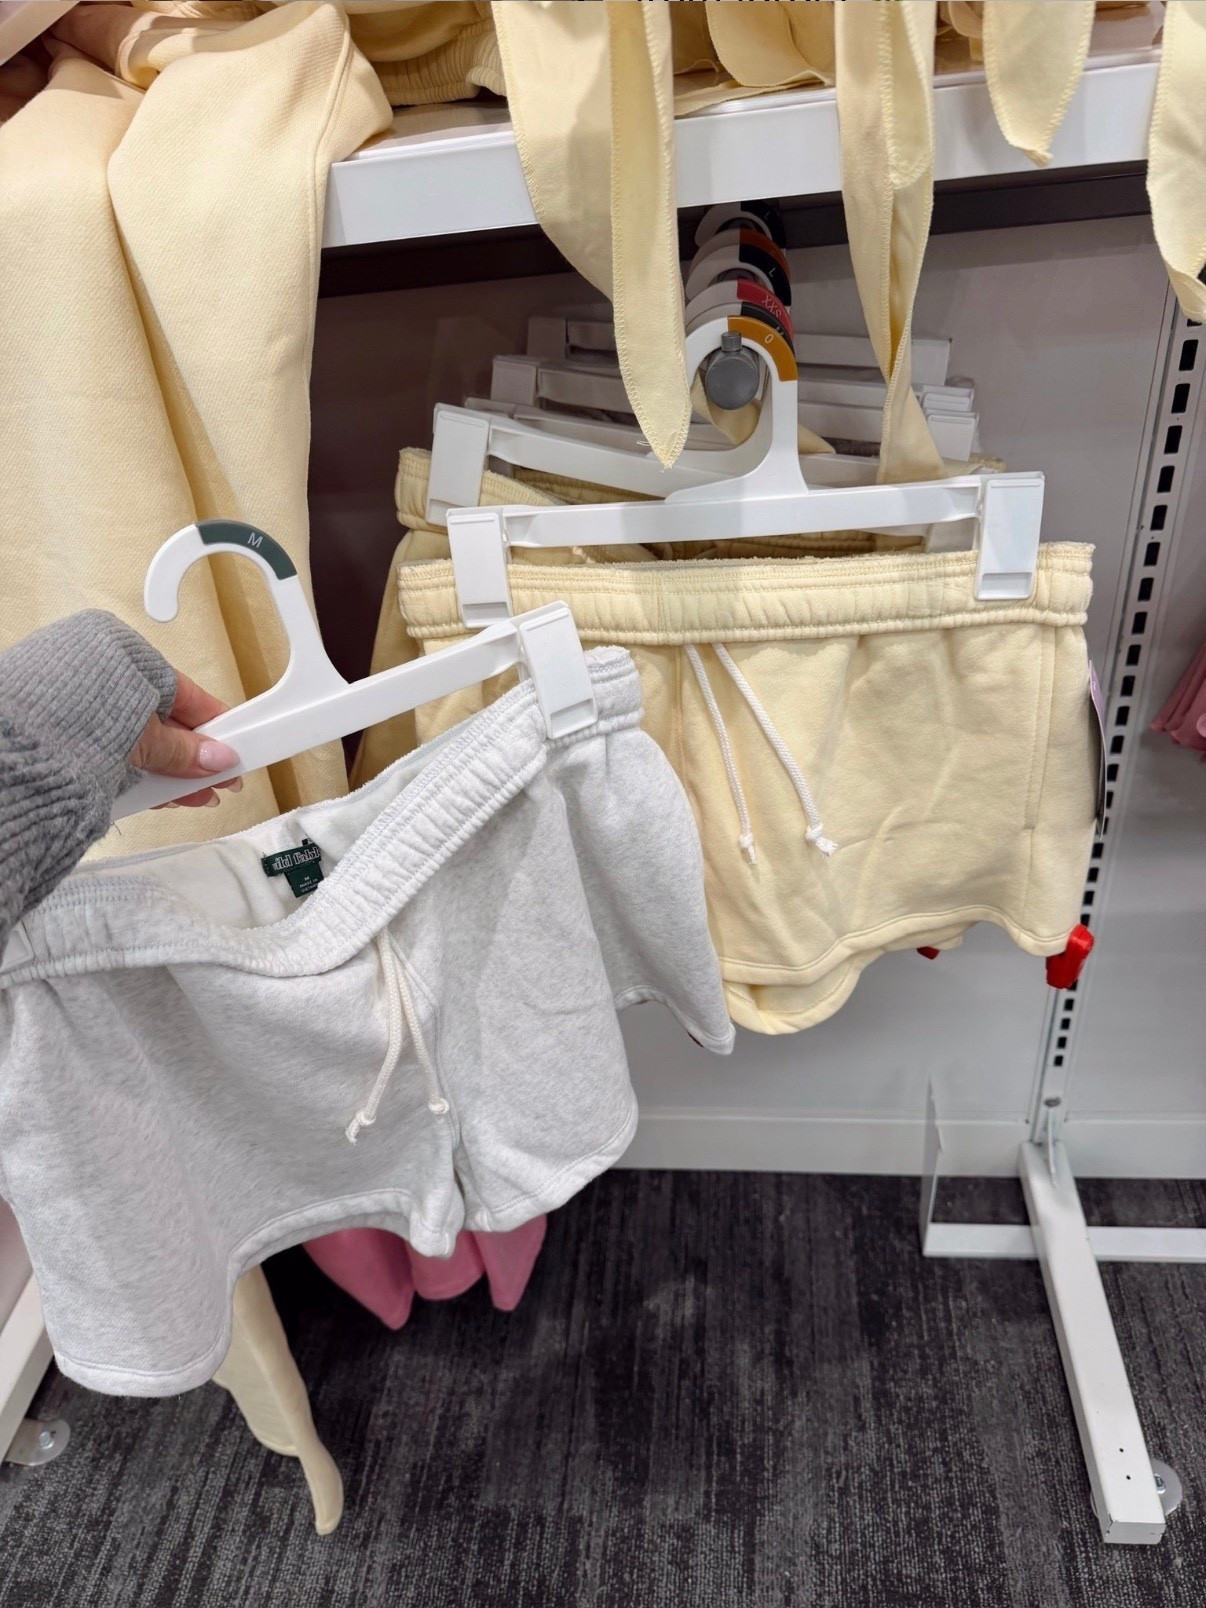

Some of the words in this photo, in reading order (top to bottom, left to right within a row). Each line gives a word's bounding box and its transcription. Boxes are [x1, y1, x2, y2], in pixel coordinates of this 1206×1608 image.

[768, 267, 776, 277] L
[761, 295, 782, 318] XXS
[247, 532, 264, 548] M
